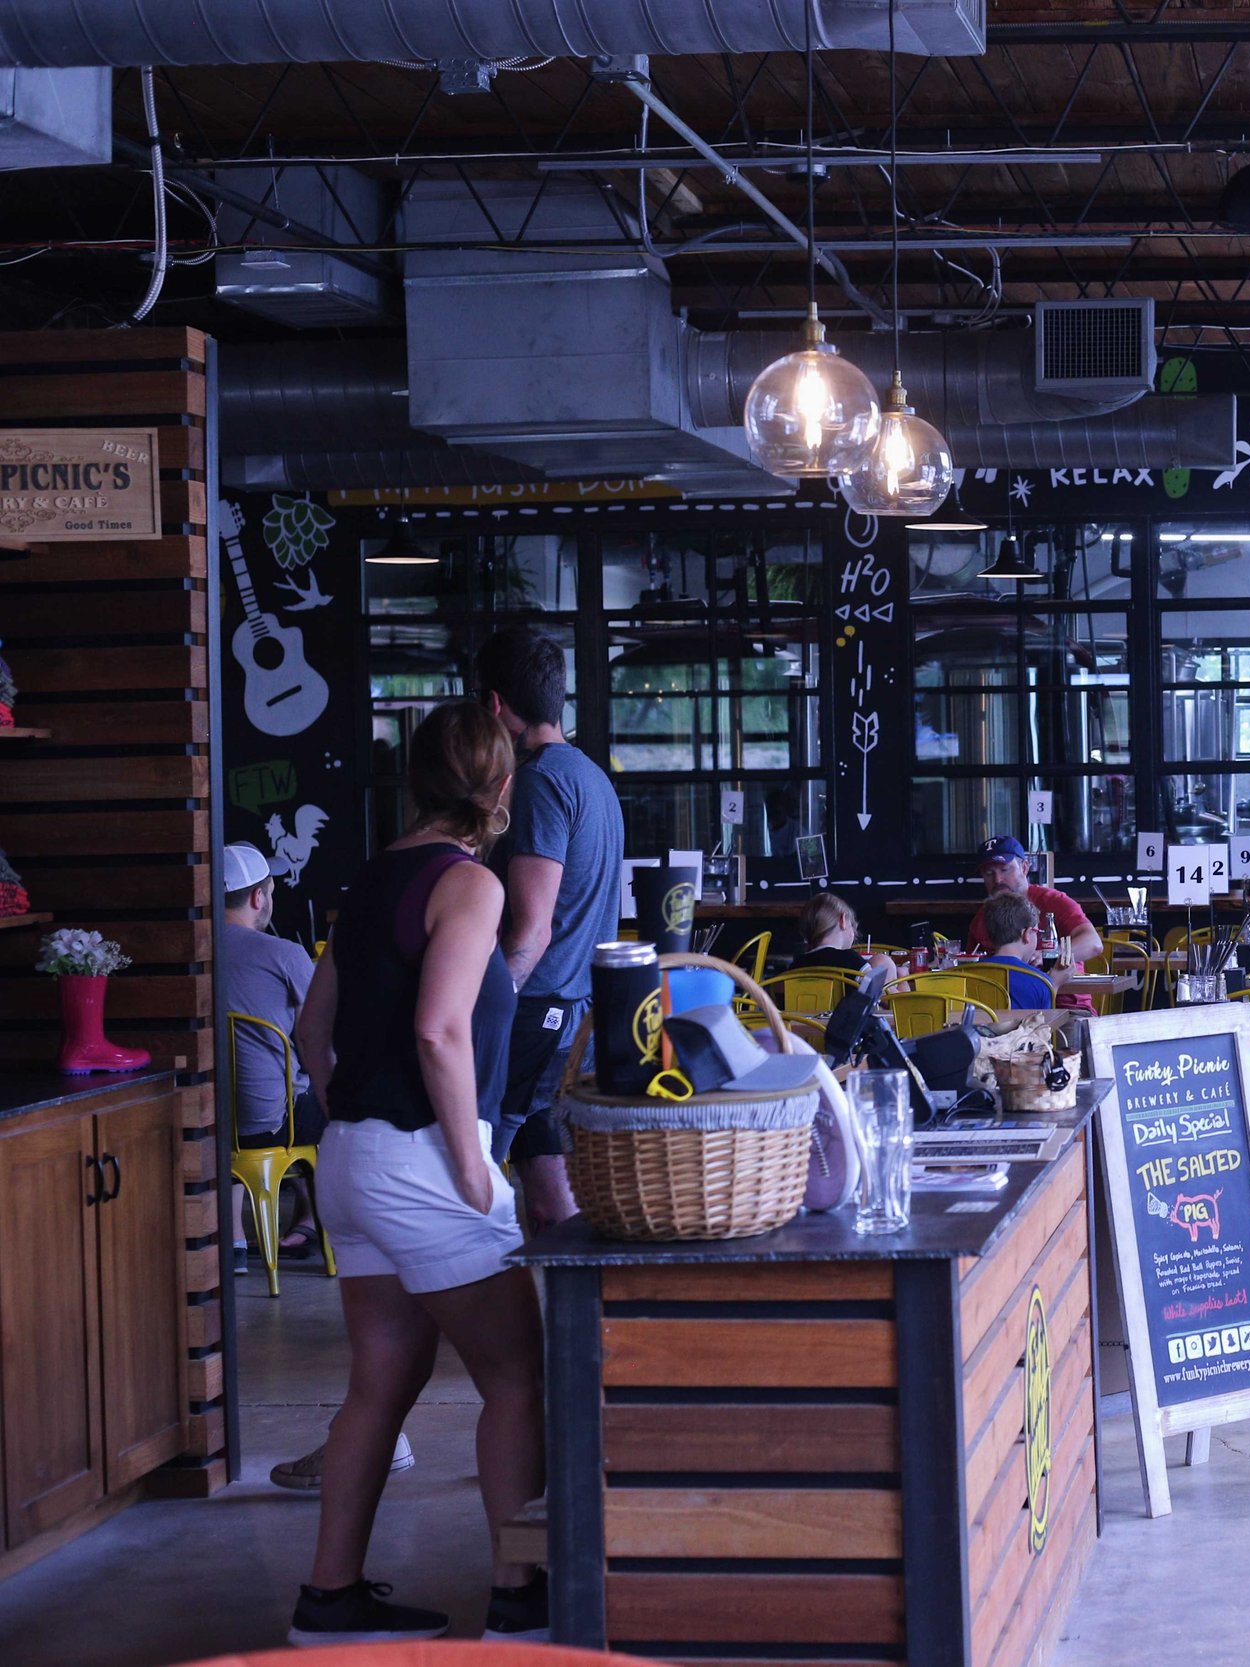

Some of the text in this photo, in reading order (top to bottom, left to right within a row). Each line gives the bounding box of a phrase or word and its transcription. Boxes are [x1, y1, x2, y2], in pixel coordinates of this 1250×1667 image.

[102, 440, 149, 464] BEER
[0, 463, 132, 490] PICNIC'S
[33, 496, 49, 509] &
[65, 520, 132, 530] Good Times
[235, 761, 293, 802] FTW
[728, 802, 737, 813] 2
[1036, 802, 1045, 812] 3
[985, 839, 998, 851] T
[1146, 846, 1155, 857] 6
[1240, 850, 1250, 863] 9
[1176, 866, 1203, 884] 14
[1123, 1054, 1230, 1086] Funky Picnic
[1127, 1082, 1231, 1110] BREWERY & CAFÉ
[1133, 1108, 1231, 1144] Daily Special
[1136, 1149, 1241, 1191] THE SALTED
[1183, 1203, 1209, 1222] PIG
[1180, 1264, 1190, 1274] Red
[1159, 1279, 1173, 1288] with
